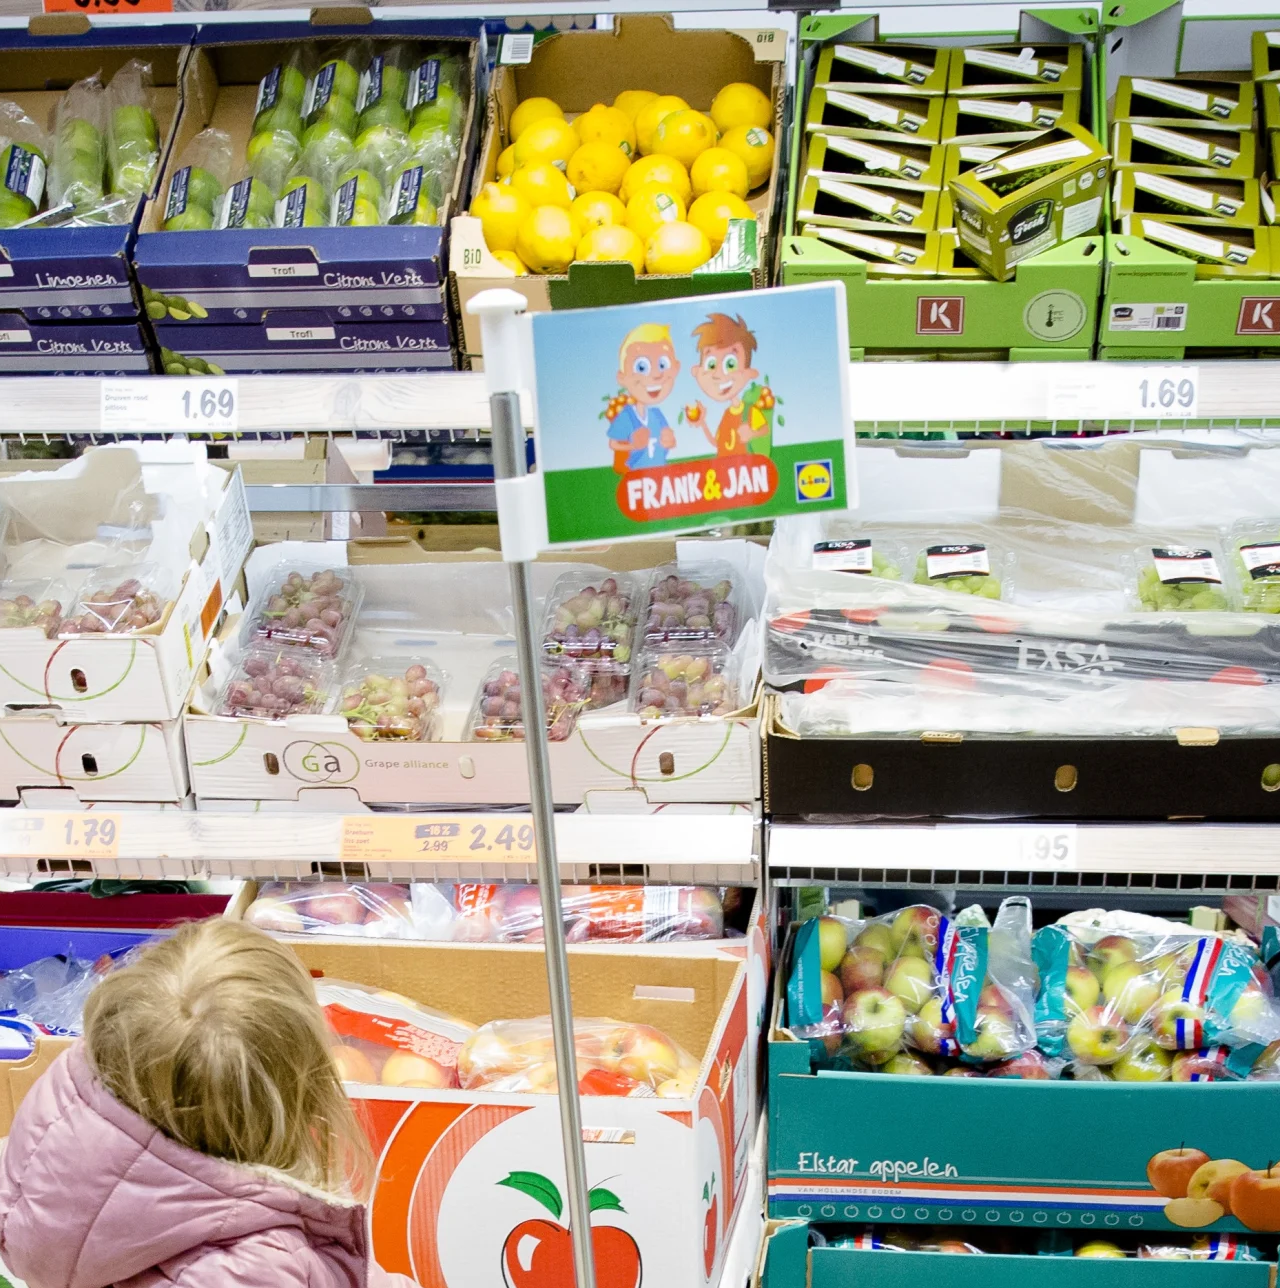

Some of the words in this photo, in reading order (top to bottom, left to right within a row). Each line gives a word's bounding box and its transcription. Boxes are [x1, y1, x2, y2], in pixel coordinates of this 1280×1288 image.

[35, 272, 118, 288] Limoenen
[324, 272, 376, 287] Citrons
[381, 271, 424, 287] Verts
[37, 338, 88, 353] Citrons
[91, 338, 133, 353] Verts
[340, 336, 391, 350] Citrons
[396, 335, 438, 350] Verts
[181, 388, 235, 418] 1.69
[1139, 379, 1194, 408] 1.69
[627, 471, 703, 511] FRANK
[702, 470, 722, 501] &
[724, 465, 769, 498] JAN
[1017, 641, 1114, 671] EXSA
[364, 759, 400, 770] Grape
[402, 758, 449, 769] alliance
[64, 818, 116, 846] 1.79
[469, 823, 535, 851] 2.49
[797, 1151, 858, 1174] Elstar
[869, 1157, 958, 1182] appelen
